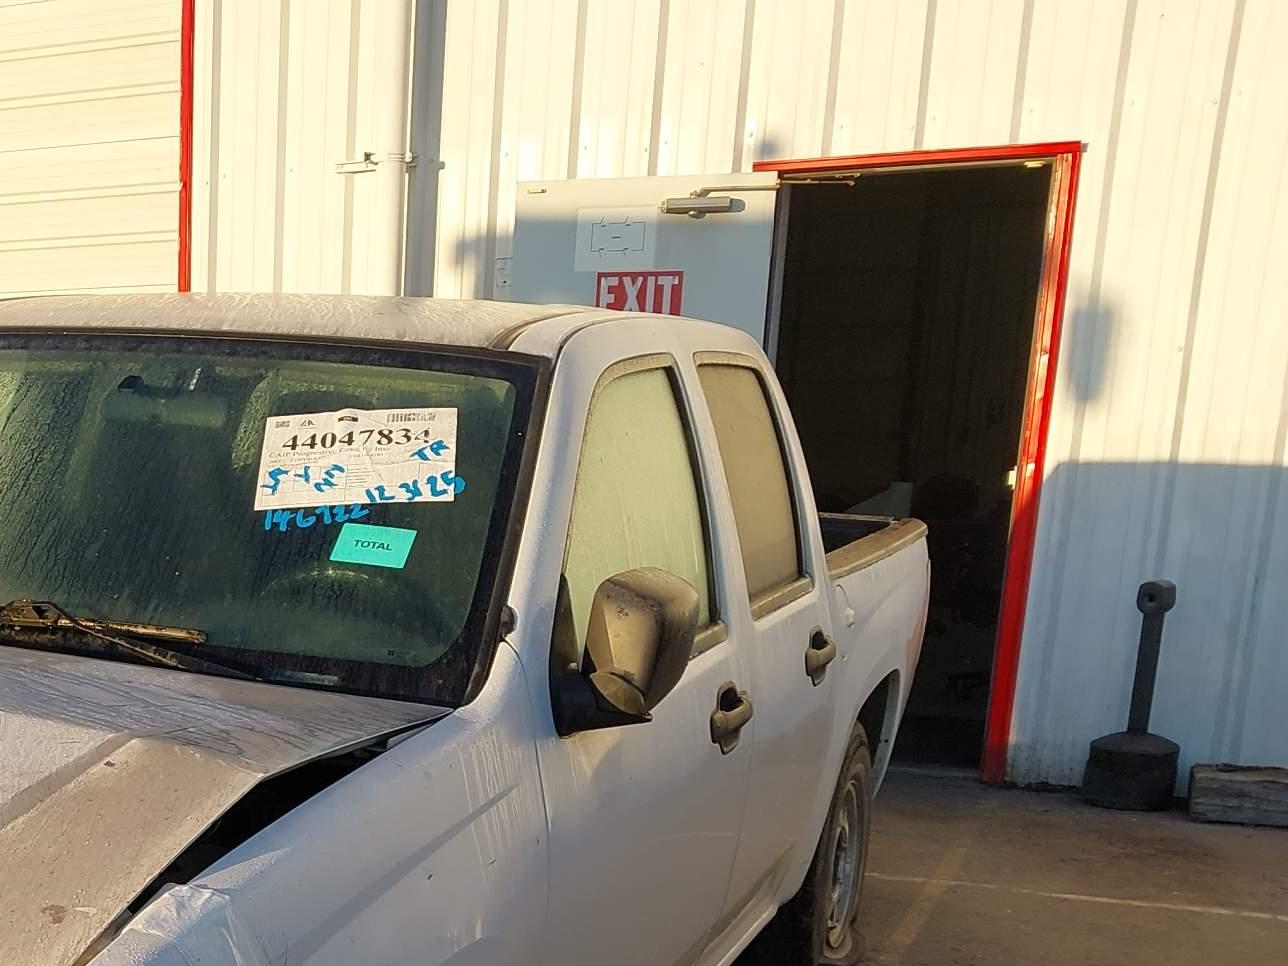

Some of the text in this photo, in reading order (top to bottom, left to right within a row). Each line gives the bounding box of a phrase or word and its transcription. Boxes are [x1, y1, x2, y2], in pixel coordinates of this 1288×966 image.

[600, 276, 679, 314] EXIT
[282, 427, 432, 451] 44047834
[354, 538, 393, 551] TOTAL
